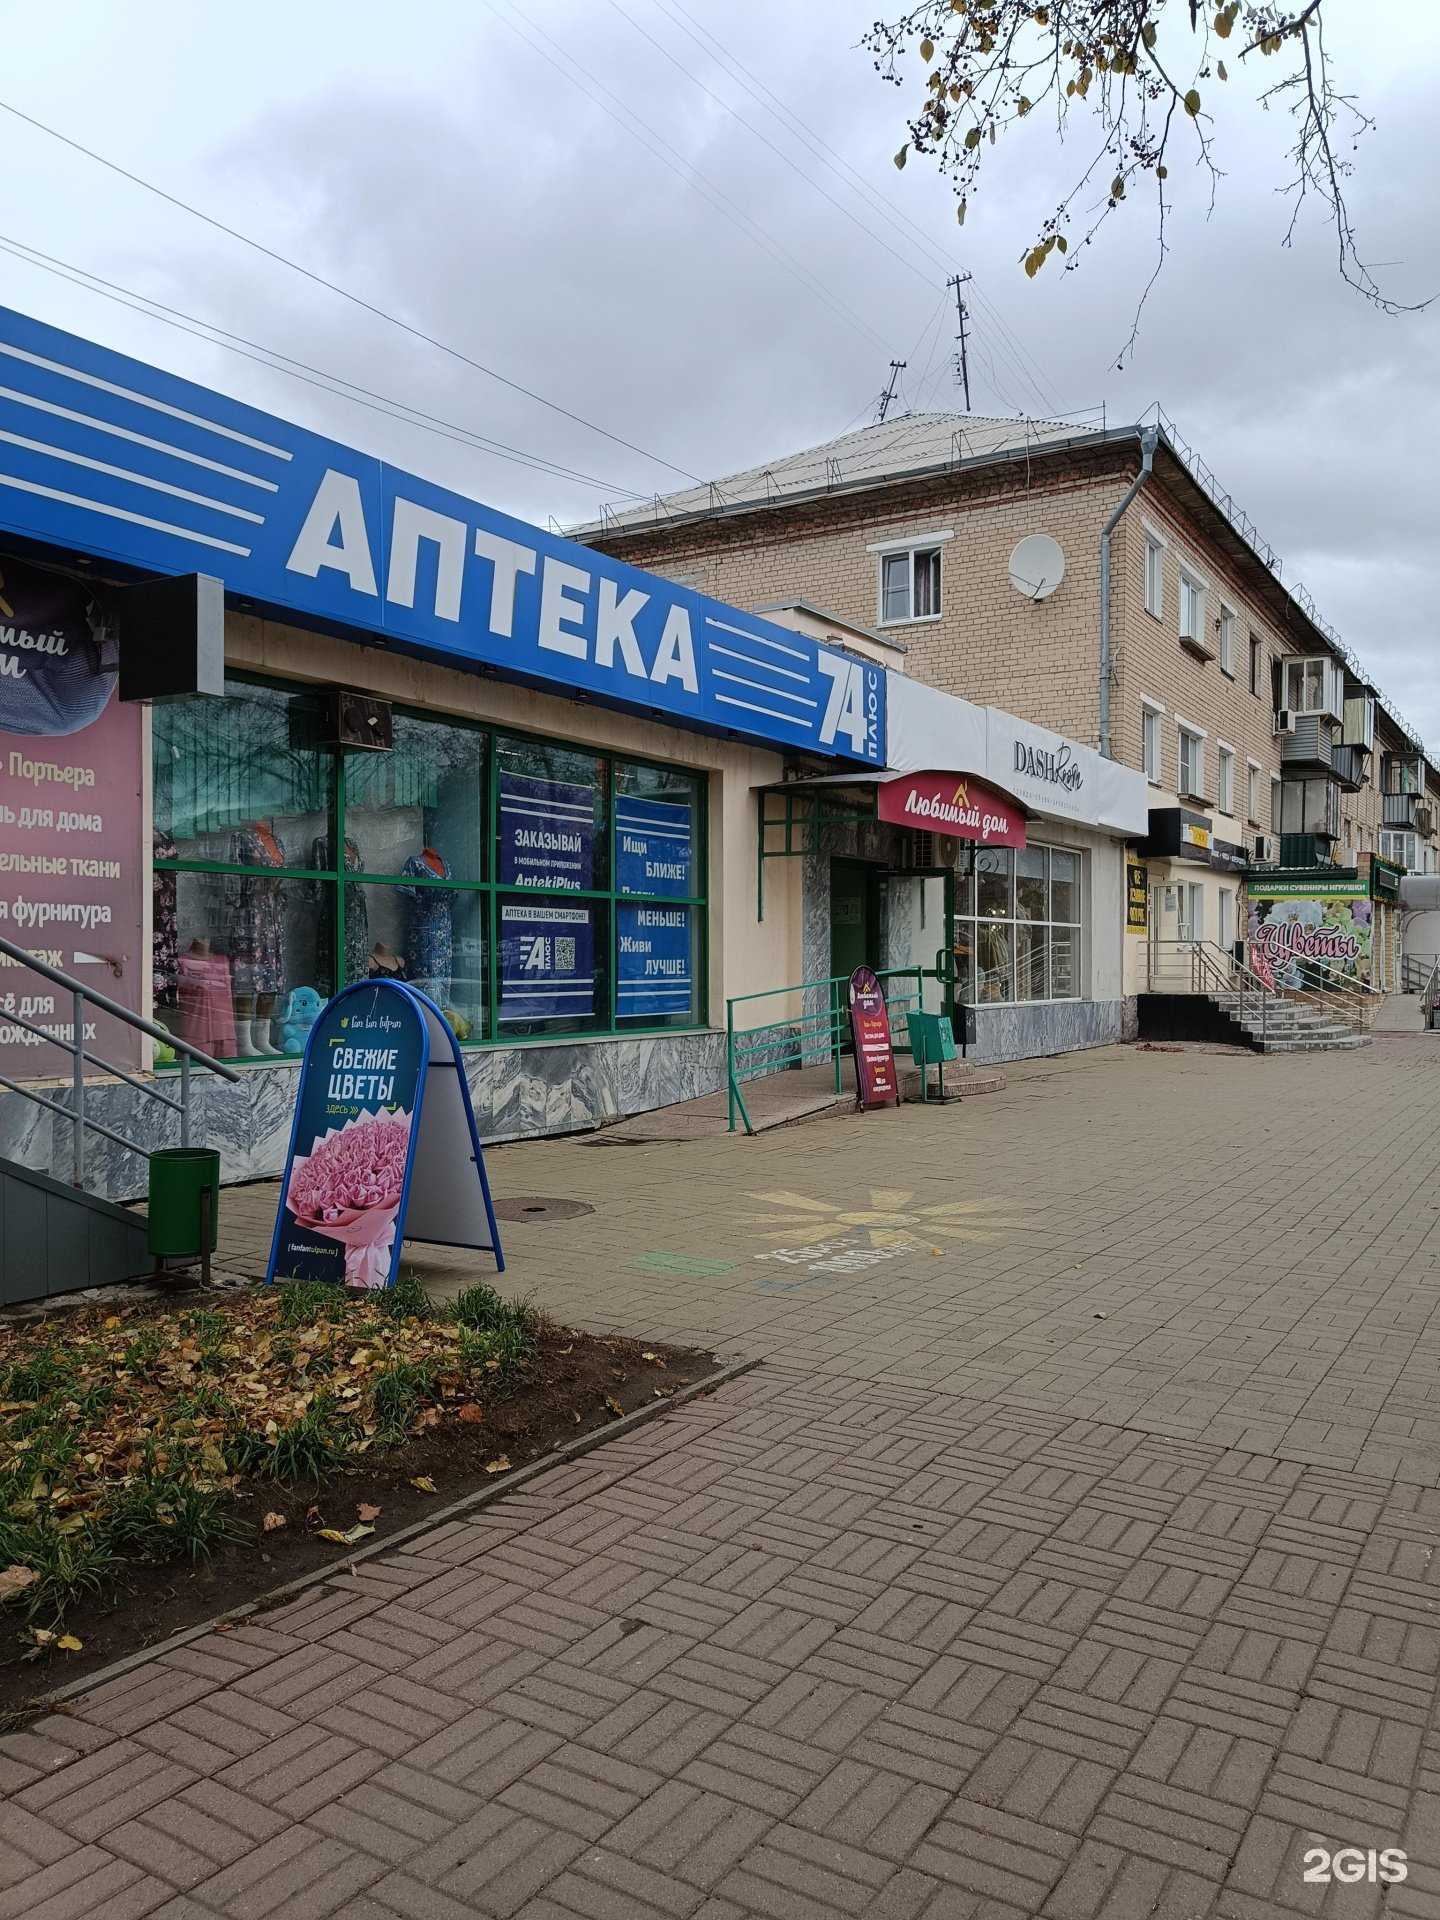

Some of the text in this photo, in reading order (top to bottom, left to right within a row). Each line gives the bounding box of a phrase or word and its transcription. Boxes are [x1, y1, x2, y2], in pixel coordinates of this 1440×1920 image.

[285, 467, 700, 695] АПТЕКА
[868, 670, 877, 758] ПЛЮС
[9, 751, 95, 791] Портьера
[18, 807, 53, 829] для
[56, 811, 102, 833] дома
[904, 789, 981, 828] Любимый
[982, 813, 1008, 839] дом
[514, 828, 582, 852] ЗАКАЗЫВАЙ
[623, 835, 648, 857] Ищи
[70, 857, 121, 879] ткани
[645, 861, 685, 881] БЛИЖЕ!
[12, 895, 112, 930] фурнитура
[505, 908, 528, 918] АПТЕКА
[637, 910, 685, 928] МЕНЬШЕ!
[620, 936, 652, 953] Живи
[1256, 922, 1360, 970] Цветы
[644, 959, 685, 976] ЛУЧШЕ!
[19, 996, 55, 1018] для
[333, 1048, 398, 1070] СВЕЖИЕ
[328, 1074, 395, 1101] ЦВЕТЫ
